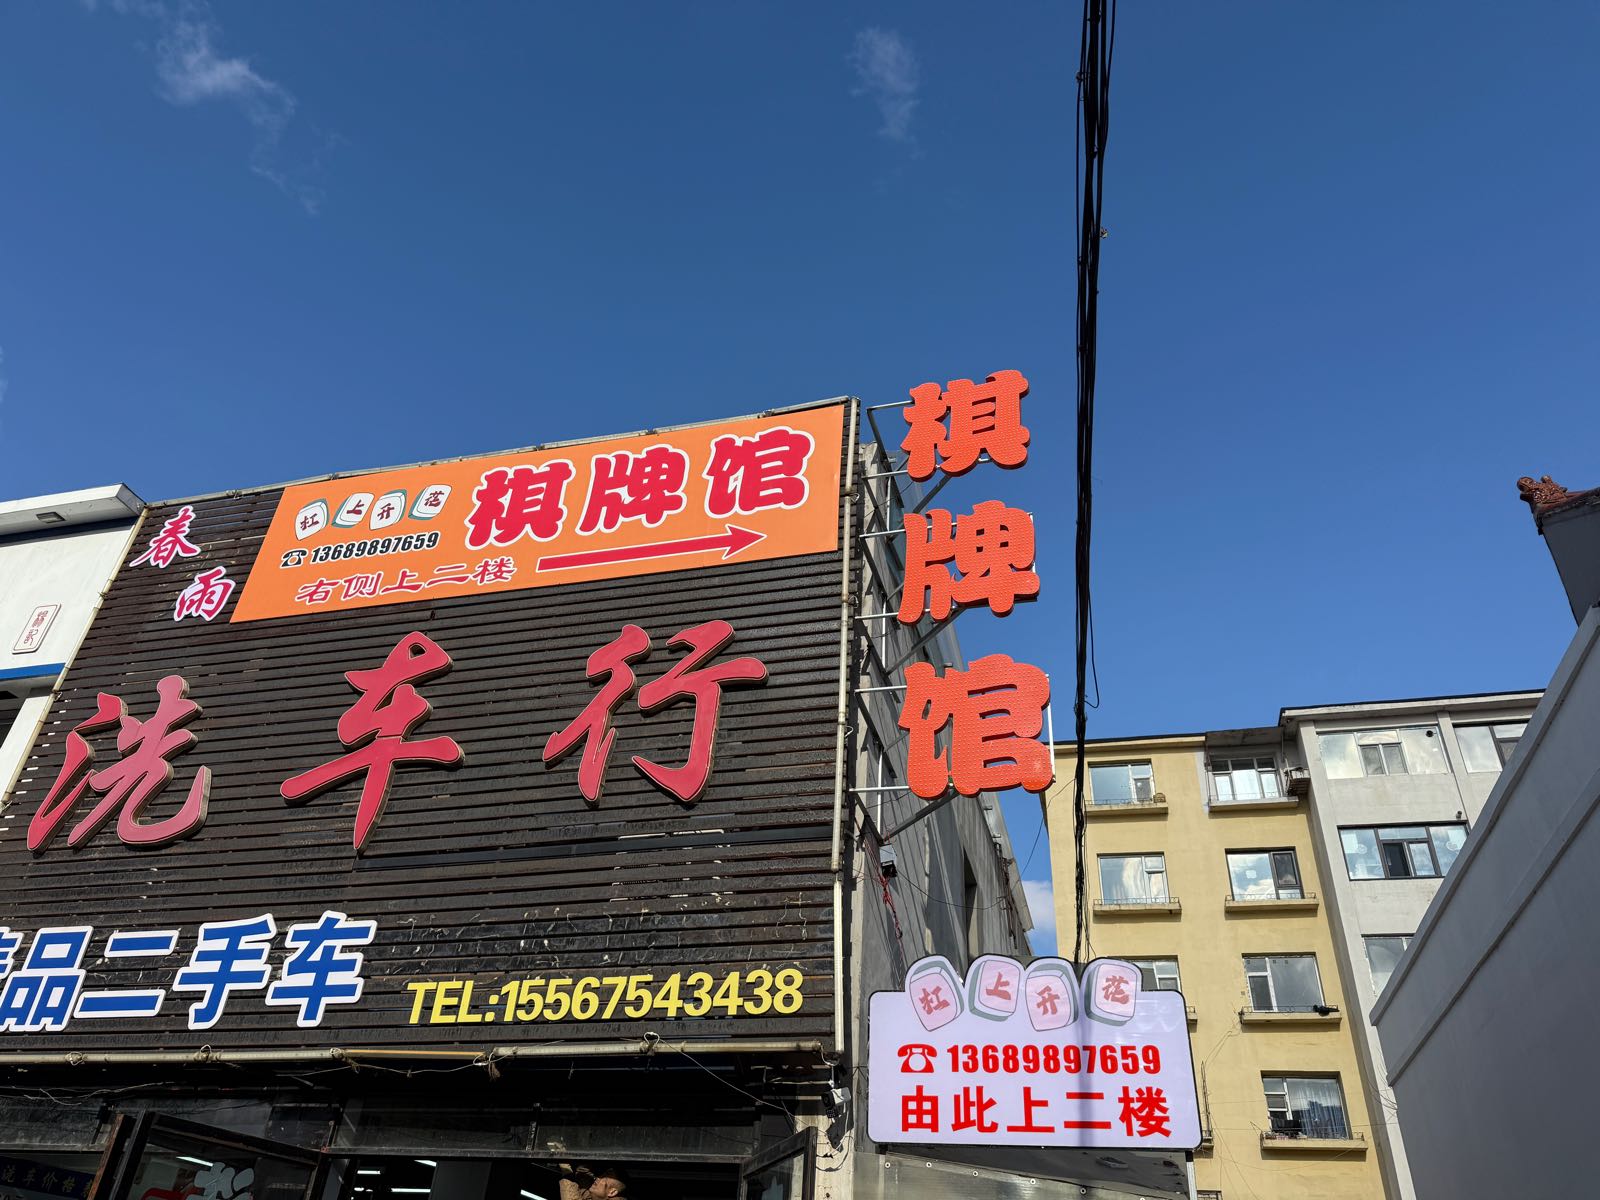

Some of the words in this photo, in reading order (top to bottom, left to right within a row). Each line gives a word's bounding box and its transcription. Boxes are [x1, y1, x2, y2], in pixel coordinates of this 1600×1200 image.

[466, 427, 814, 549] 棋牌馆
[129, 505, 236, 621] 春雨
[310, 531, 441, 565] 13689897659
[297, 557, 516, 604] 右侧上二楼
[897, 370, 1054, 800] 棋牌馆
[27, 620, 768, 855] 洗车行
[406, 968, 803, 1024] TEL:15567543438
[947, 1044, 1161, 1075] 13689897659
[901, 1085, 1172, 1138] 由此上二楼
